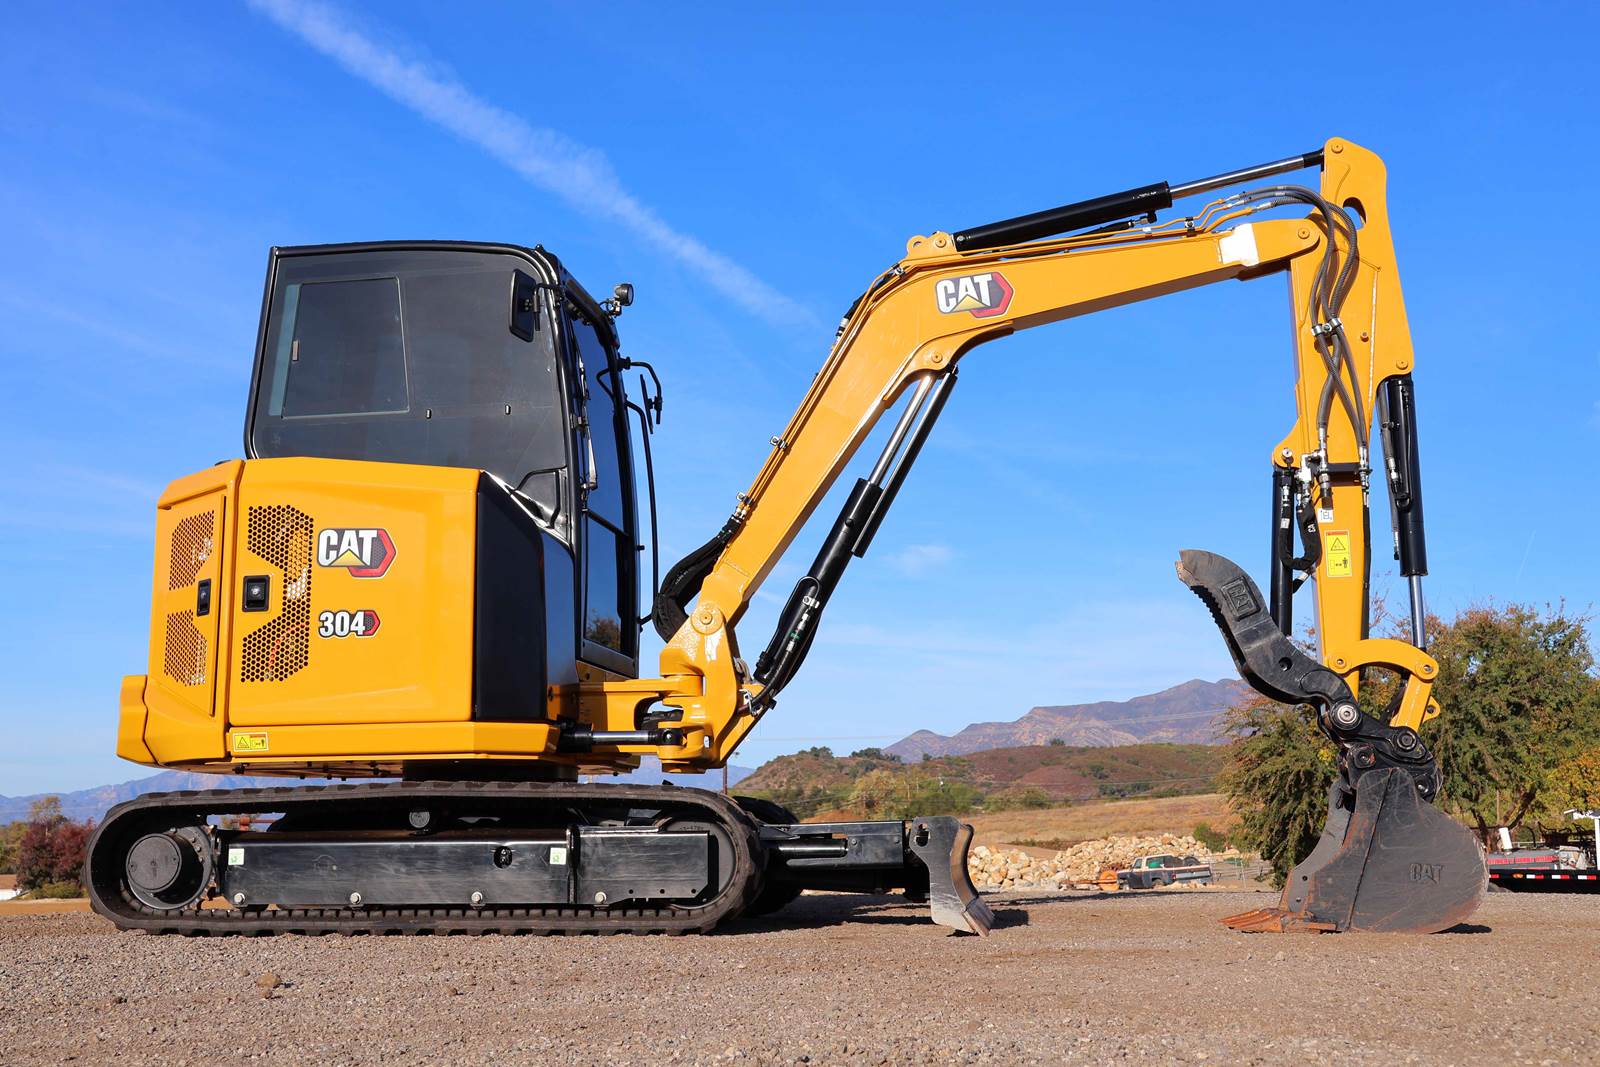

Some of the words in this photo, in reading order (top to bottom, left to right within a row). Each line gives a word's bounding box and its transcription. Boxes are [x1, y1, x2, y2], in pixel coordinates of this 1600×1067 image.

[936, 273, 993, 313] CAT
[318, 529, 378, 567] CAT
[1227, 583, 1251, 610] CAT
[319, 611, 366, 636] 304
[1409, 863, 1444, 884] CAT
